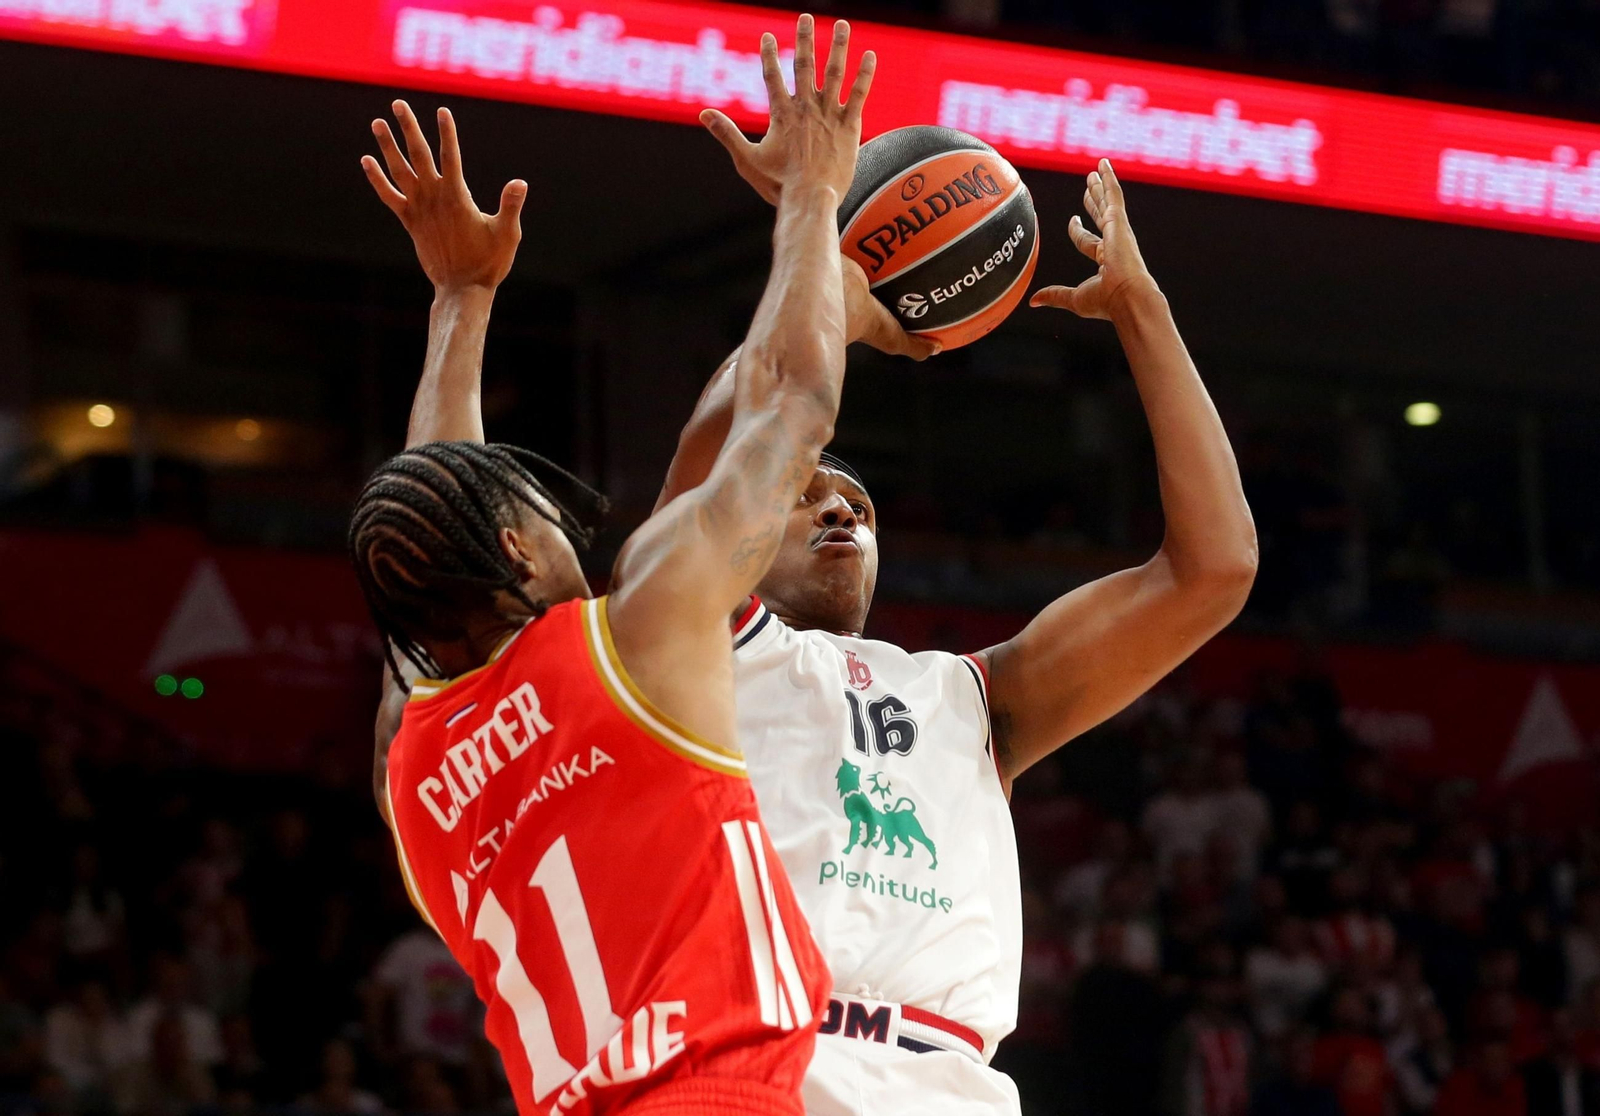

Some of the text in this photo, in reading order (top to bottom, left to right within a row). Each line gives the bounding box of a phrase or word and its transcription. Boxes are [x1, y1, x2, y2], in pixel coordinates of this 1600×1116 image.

[937, 78, 1322, 185] meridianbet
[857, 163, 1002, 274] SPALDING
[418, 681, 555, 833] CARTER
[844, 693, 919, 757] 16
[819, 860, 953, 914] plenitude
[473, 834, 625, 1105] 11
